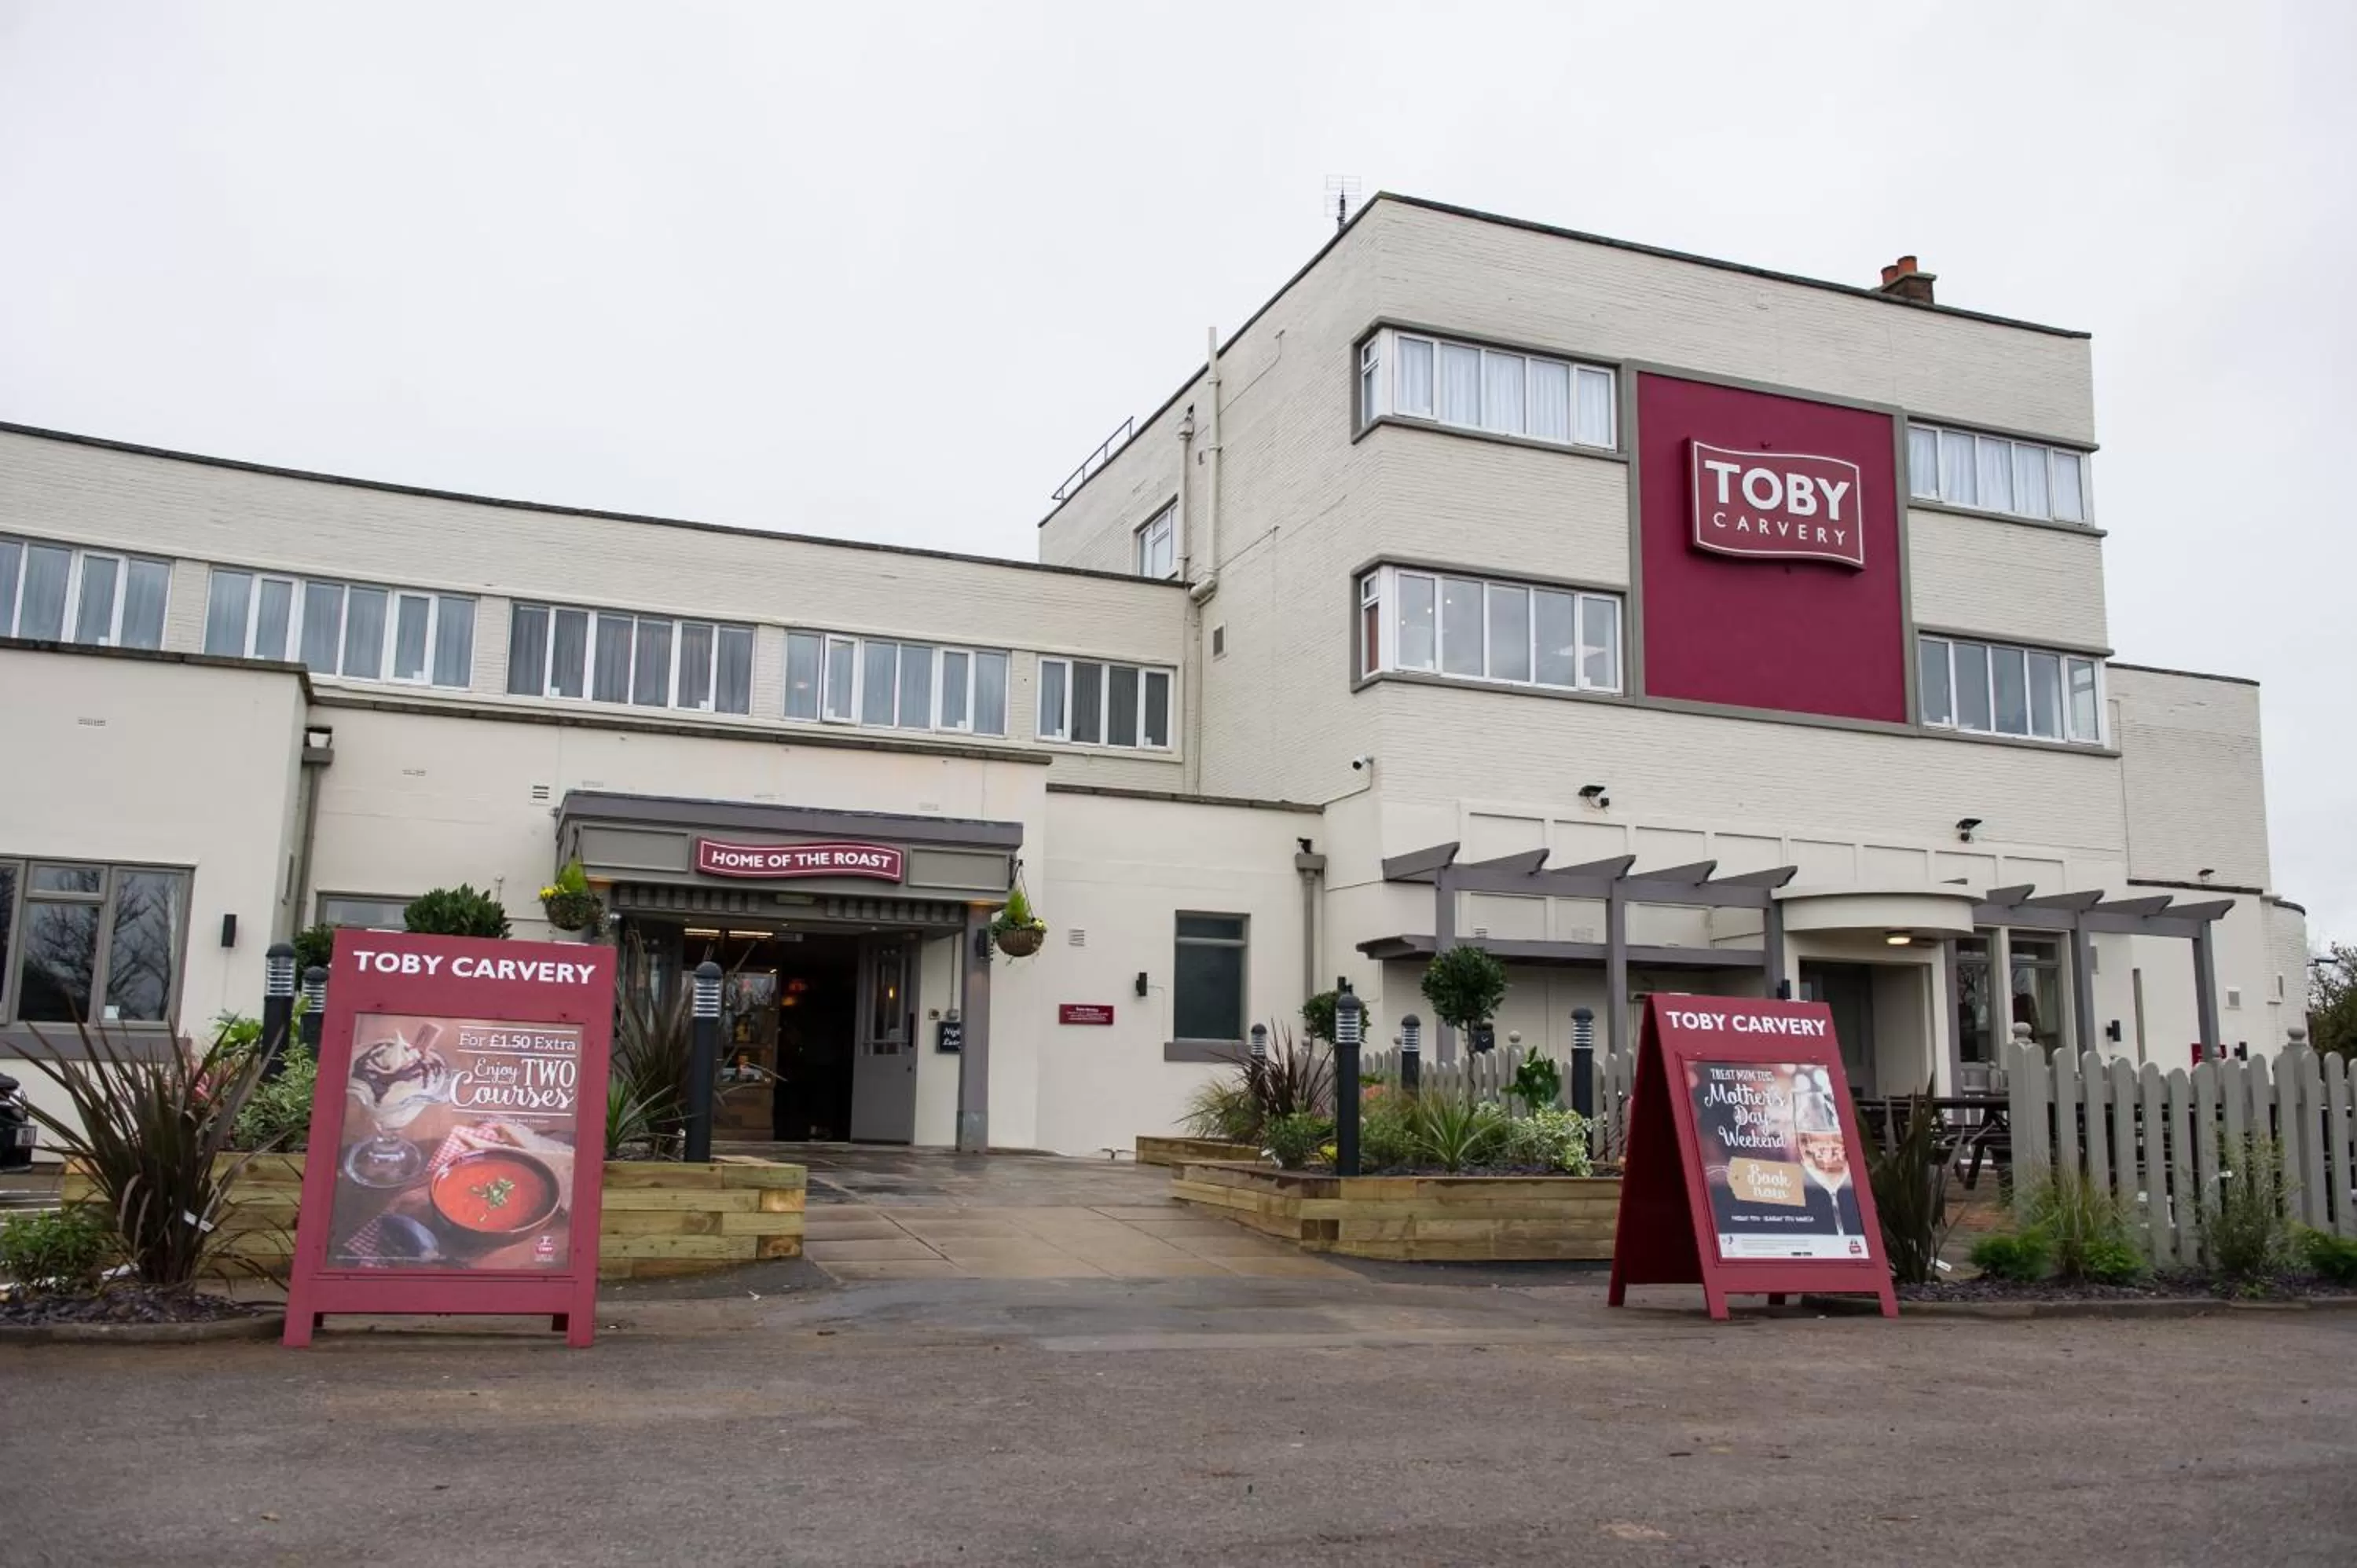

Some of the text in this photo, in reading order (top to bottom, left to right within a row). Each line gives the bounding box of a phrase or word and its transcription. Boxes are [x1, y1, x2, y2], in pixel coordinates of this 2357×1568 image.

[1704, 460, 1850, 521] TOBY
[1713, 511, 1846, 546] CARVERY
[711, 850, 893, 868] HOME OF THE ROAST
[353, 951, 596, 984] TOBY CARVERY
[1666, 1011, 1826, 1036] TOBY CARVERY
[458, 1033, 576, 1050] For £1.50 Extra
[474, 1057, 576, 1088] Enjoy TWO
[1734, 1105, 1769, 1136] Day
[1717, 1124, 1786, 1147] Weekend
[1747, 1163, 1792, 1186] Book
